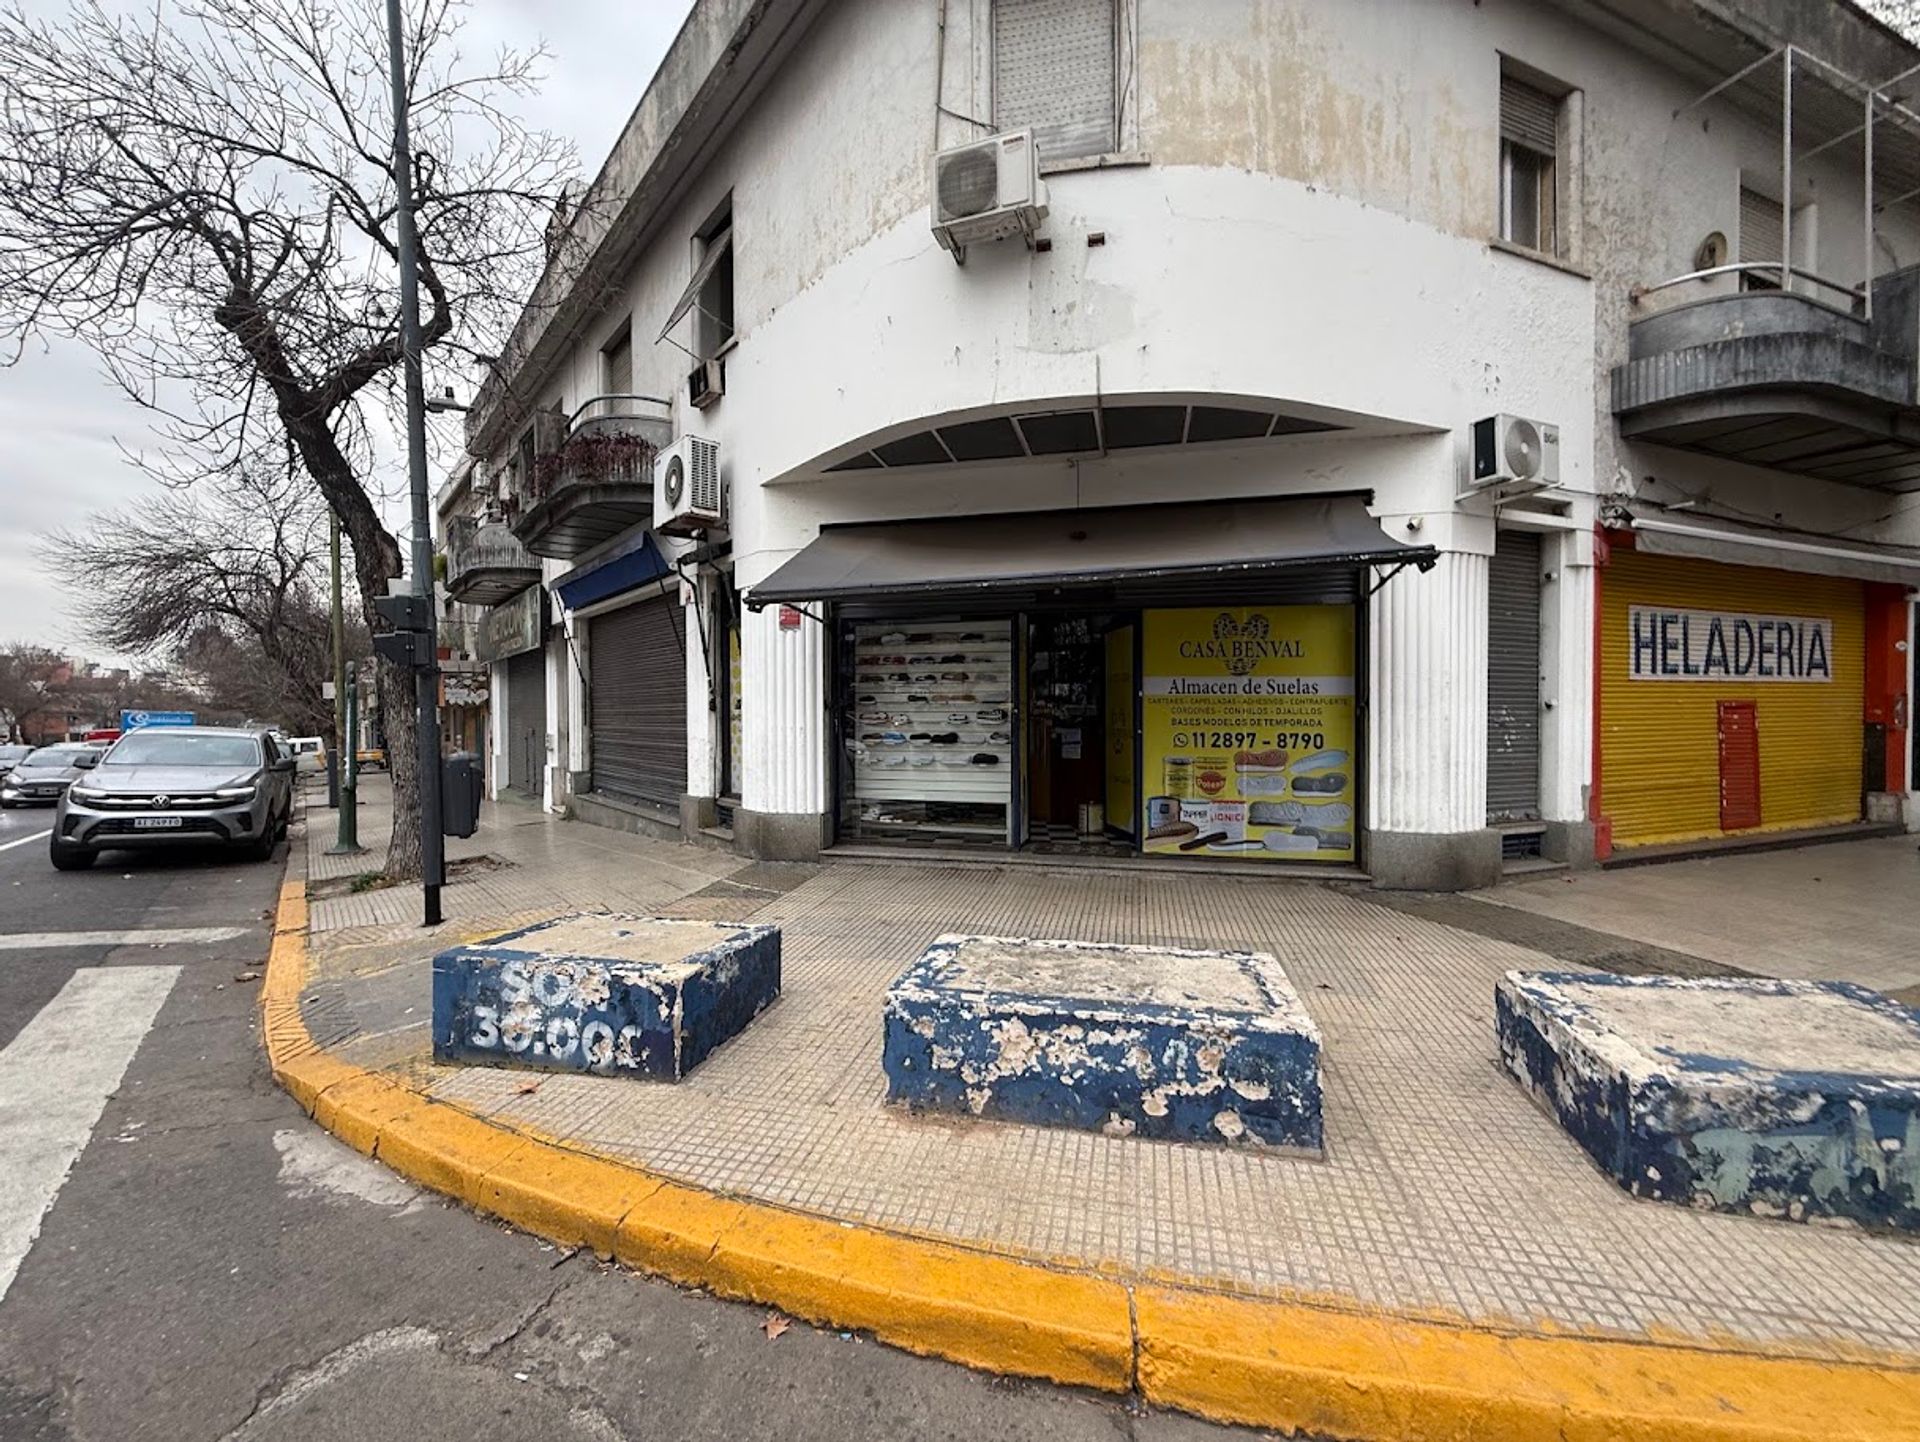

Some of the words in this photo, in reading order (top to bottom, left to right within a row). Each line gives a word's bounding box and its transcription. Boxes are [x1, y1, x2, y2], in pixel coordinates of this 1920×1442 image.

[1179, 640, 1227, 658] CASA
[1232, 640, 1306, 658] BENVAL
[1633, 611, 1831, 678] HELADERIA
[1168, 677, 1238, 695] Almacen
[1242, 677, 1262, 695] de
[1266, 677, 1320, 695] Suelas
[1171, 718, 1201, 726] BASES
[1203, 718, 1248, 726] MODELOS
[1250, 718, 1262, 727] DE
[1264, 719, 1323, 727] TEMPORADA
[1192, 732, 1206, 748] 11
[1211, 732, 1257, 748] 2897
[1277, 733, 1324, 749] 8790
